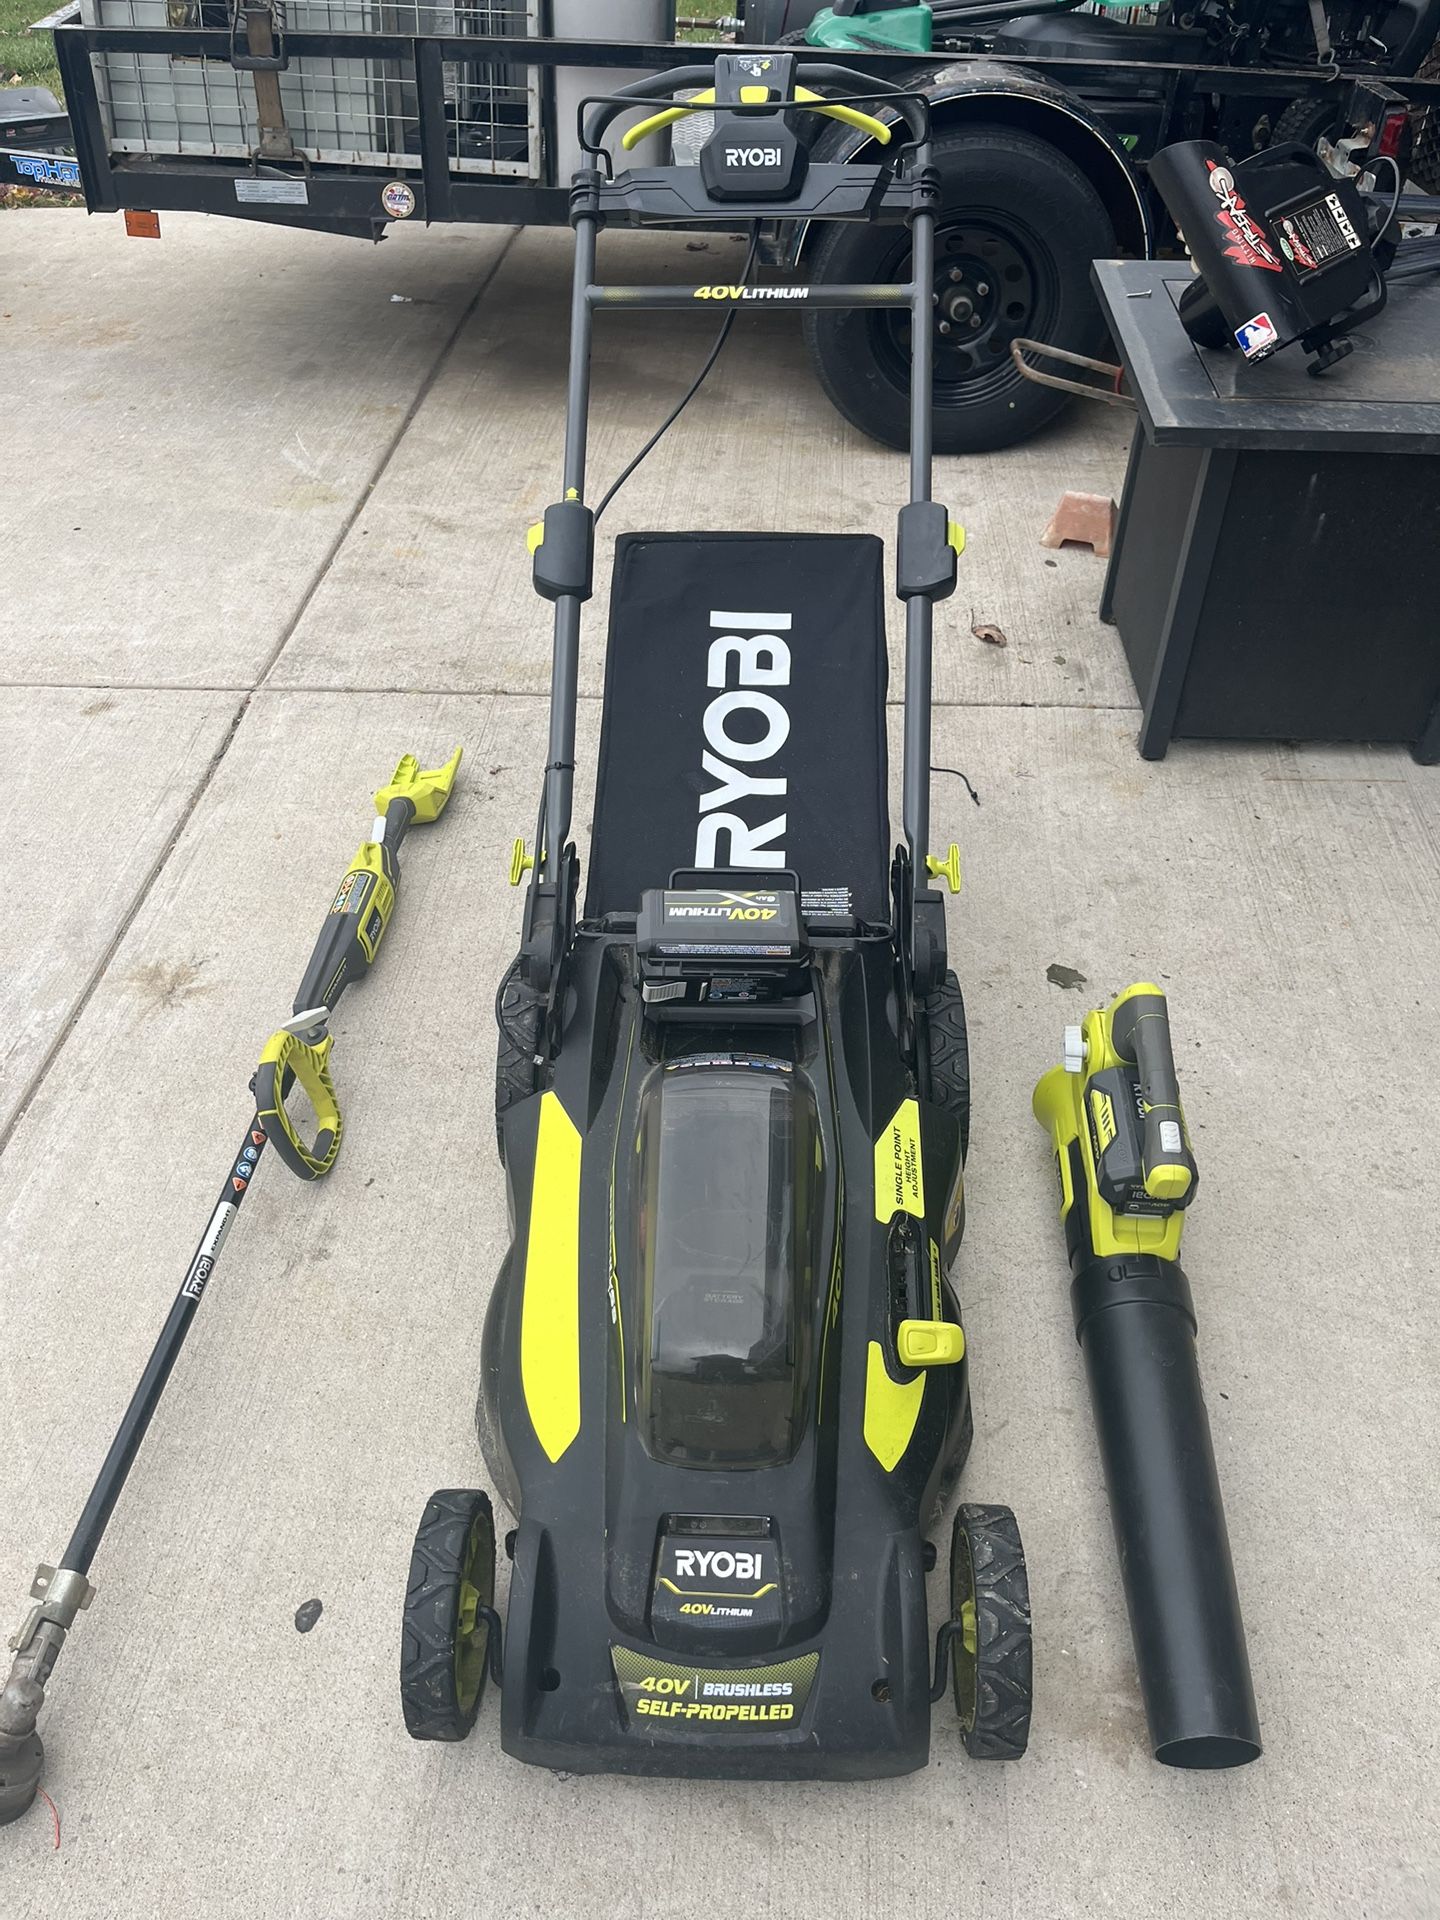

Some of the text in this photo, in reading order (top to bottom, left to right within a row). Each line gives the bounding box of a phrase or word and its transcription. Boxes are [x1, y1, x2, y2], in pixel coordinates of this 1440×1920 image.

[725, 148, 782, 167] RYOBI
[694, 610, 792, 869] RYOBI
[893, 1126, 904, 1205] SINGLE POINT
[903, 1150, 911, 1183] HEIGHT
[910, 1137, 919, 1199] ADJUSTMENT
[211, 1209, 231, 1252] EXPAND-IT
[189, 1255, 213, 1294] RYOBI
[675, 1550, 762, 1580] RYOBI
[639, 1676, 793, 1697] 40V BRUSHLESS
[636, 1698, 794, 1721] SELF-PROPELLED
